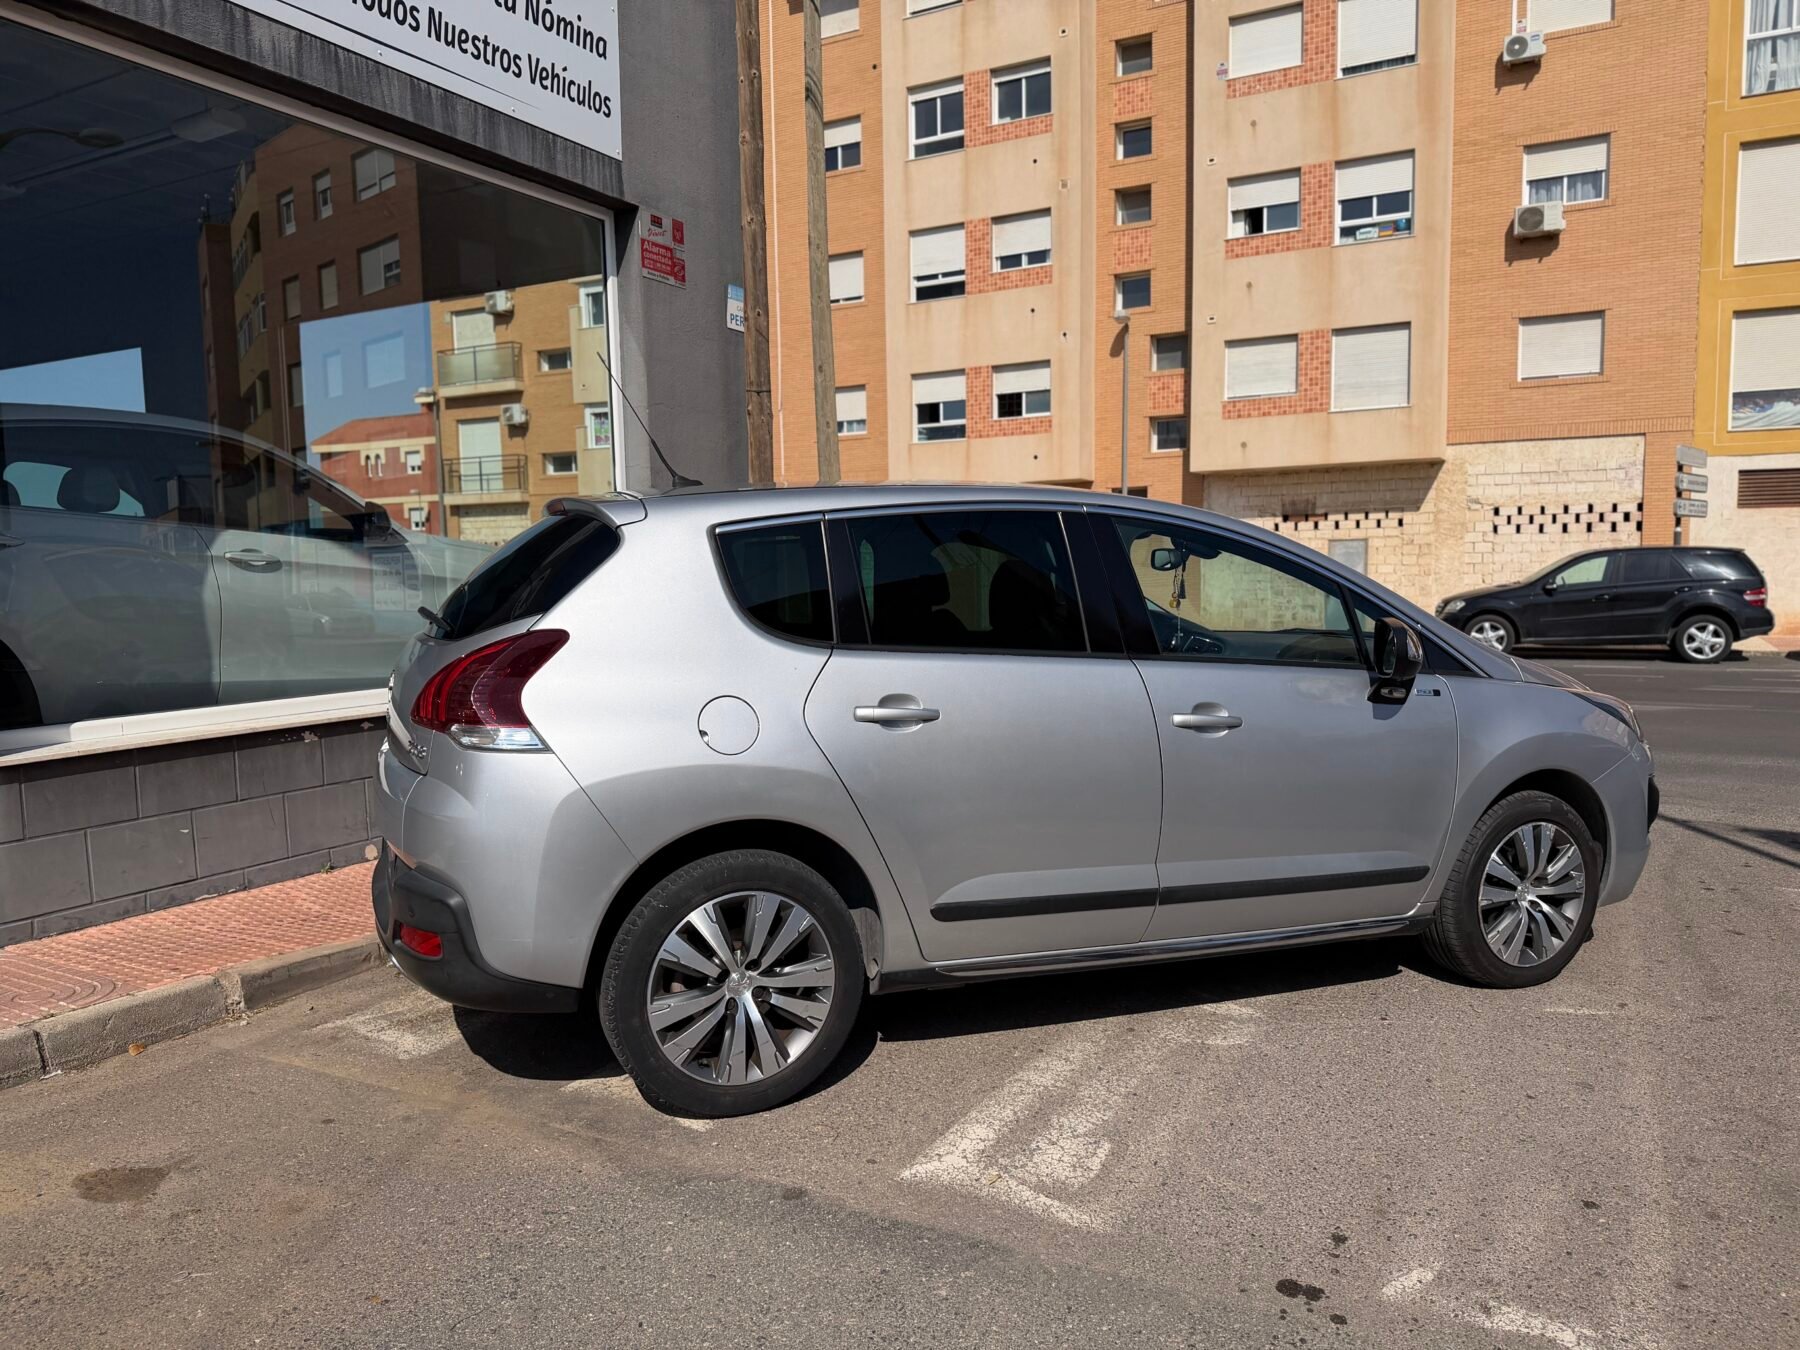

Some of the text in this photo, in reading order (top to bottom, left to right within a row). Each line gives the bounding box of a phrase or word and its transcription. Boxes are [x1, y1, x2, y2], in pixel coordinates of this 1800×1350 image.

[352, 0, 612, 119] dos Nuestros Vehículos
[525, 0, 608, 60] Nómina
[643, 241, 671, 258] Alarma
